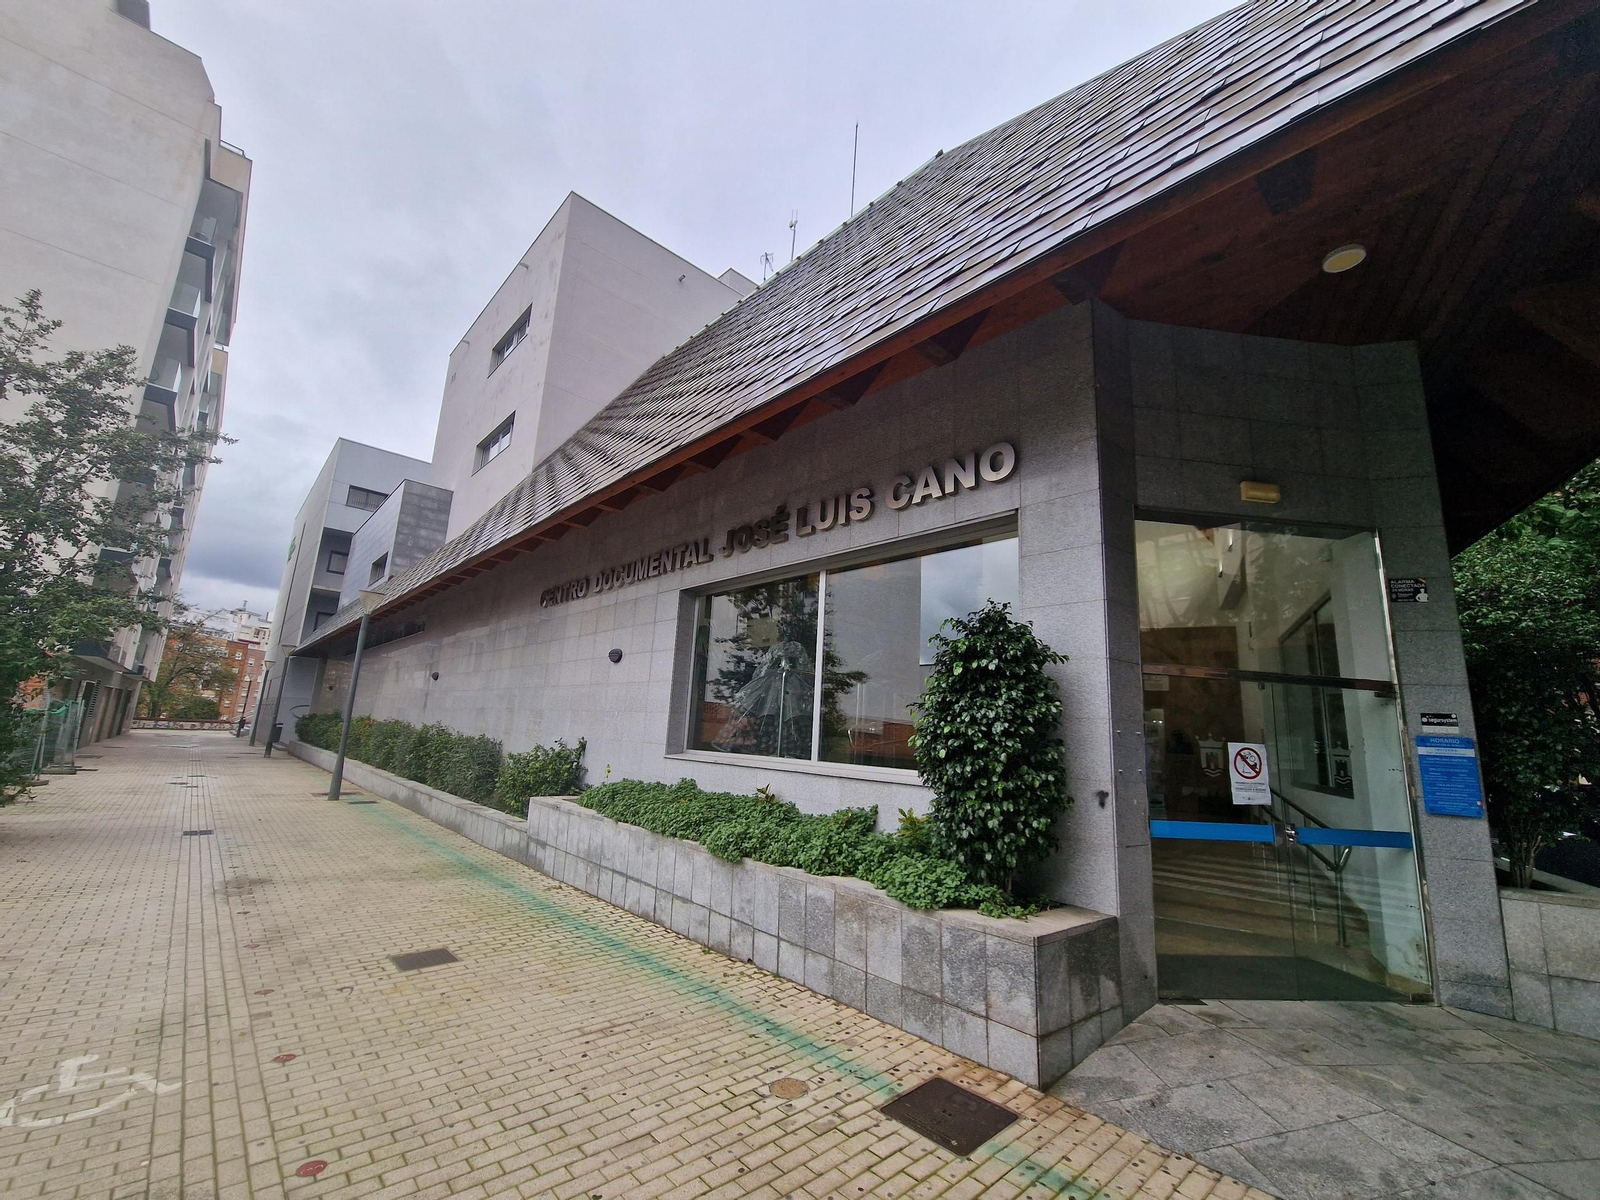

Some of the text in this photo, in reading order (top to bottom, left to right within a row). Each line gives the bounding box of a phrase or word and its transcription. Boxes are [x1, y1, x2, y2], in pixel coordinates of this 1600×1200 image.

[539, 441, 1018, 608] CENTRO DOCUMENTAL JOSÉ LUIS CANO
